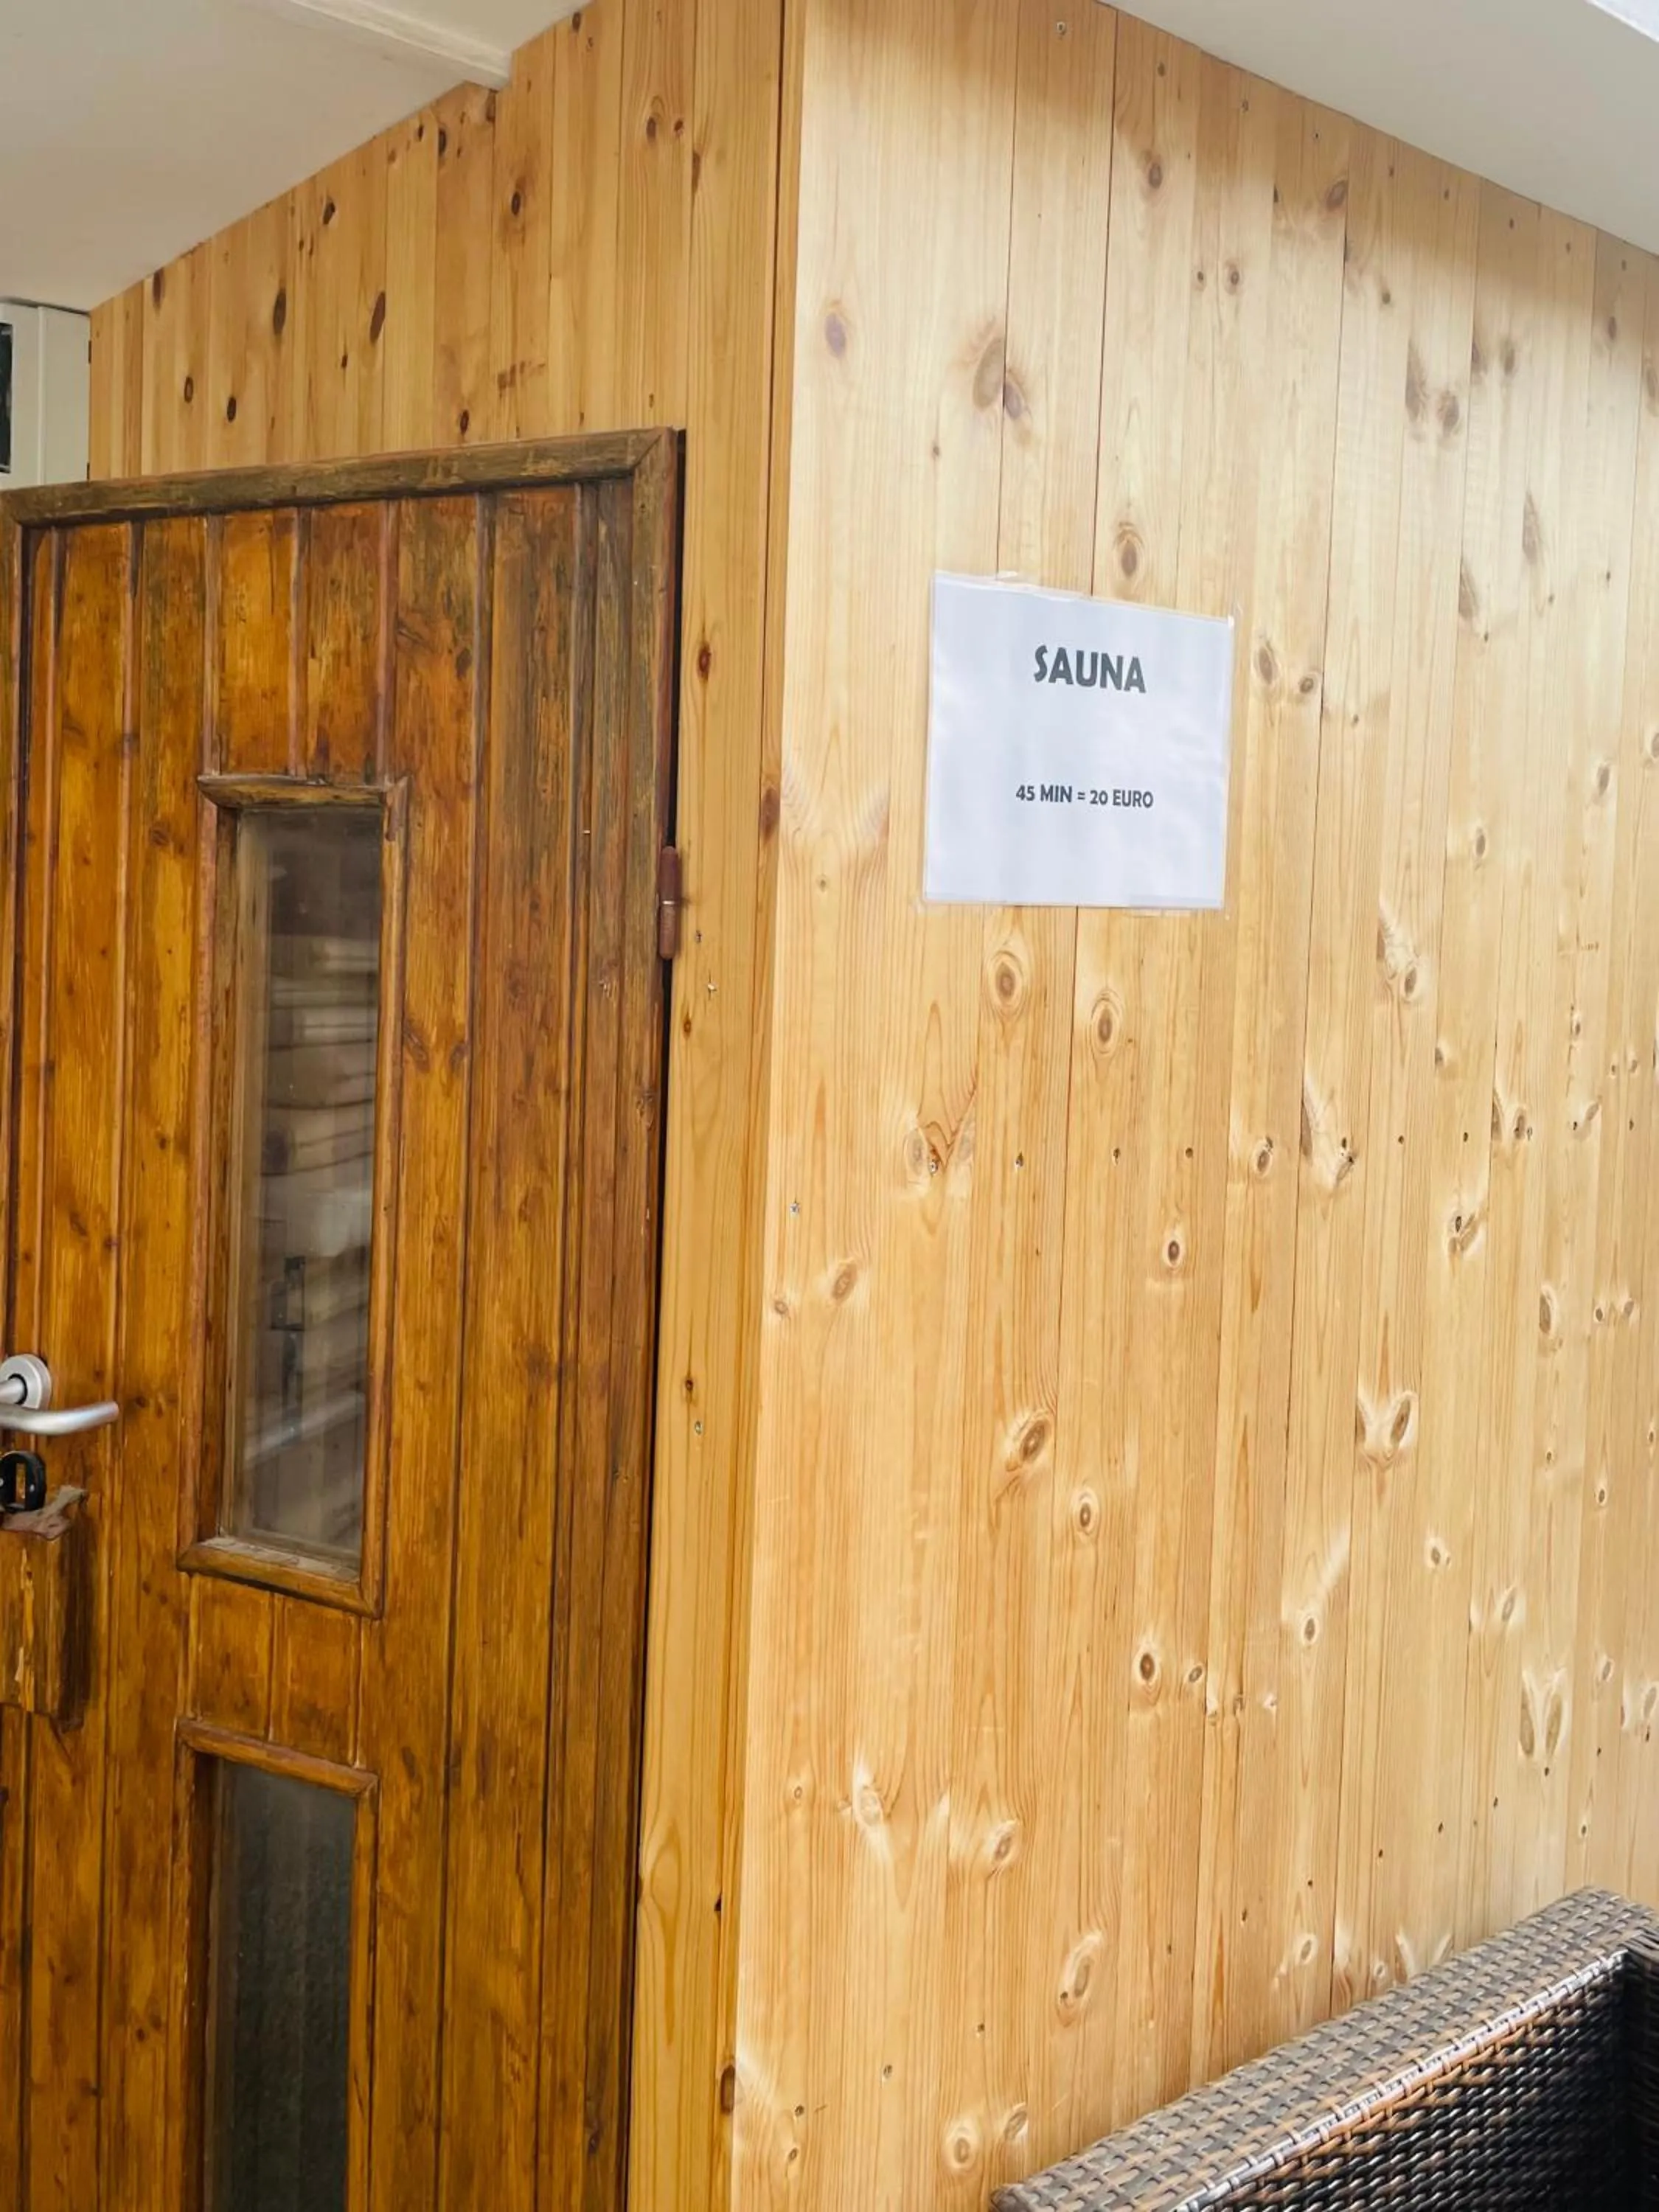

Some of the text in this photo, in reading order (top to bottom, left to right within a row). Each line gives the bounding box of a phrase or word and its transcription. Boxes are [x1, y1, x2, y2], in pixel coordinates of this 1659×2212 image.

[1033, 645, 1147, 693] SAUNA
[1015, 785, 1153, 808] 45 MIN = 20 EURO
